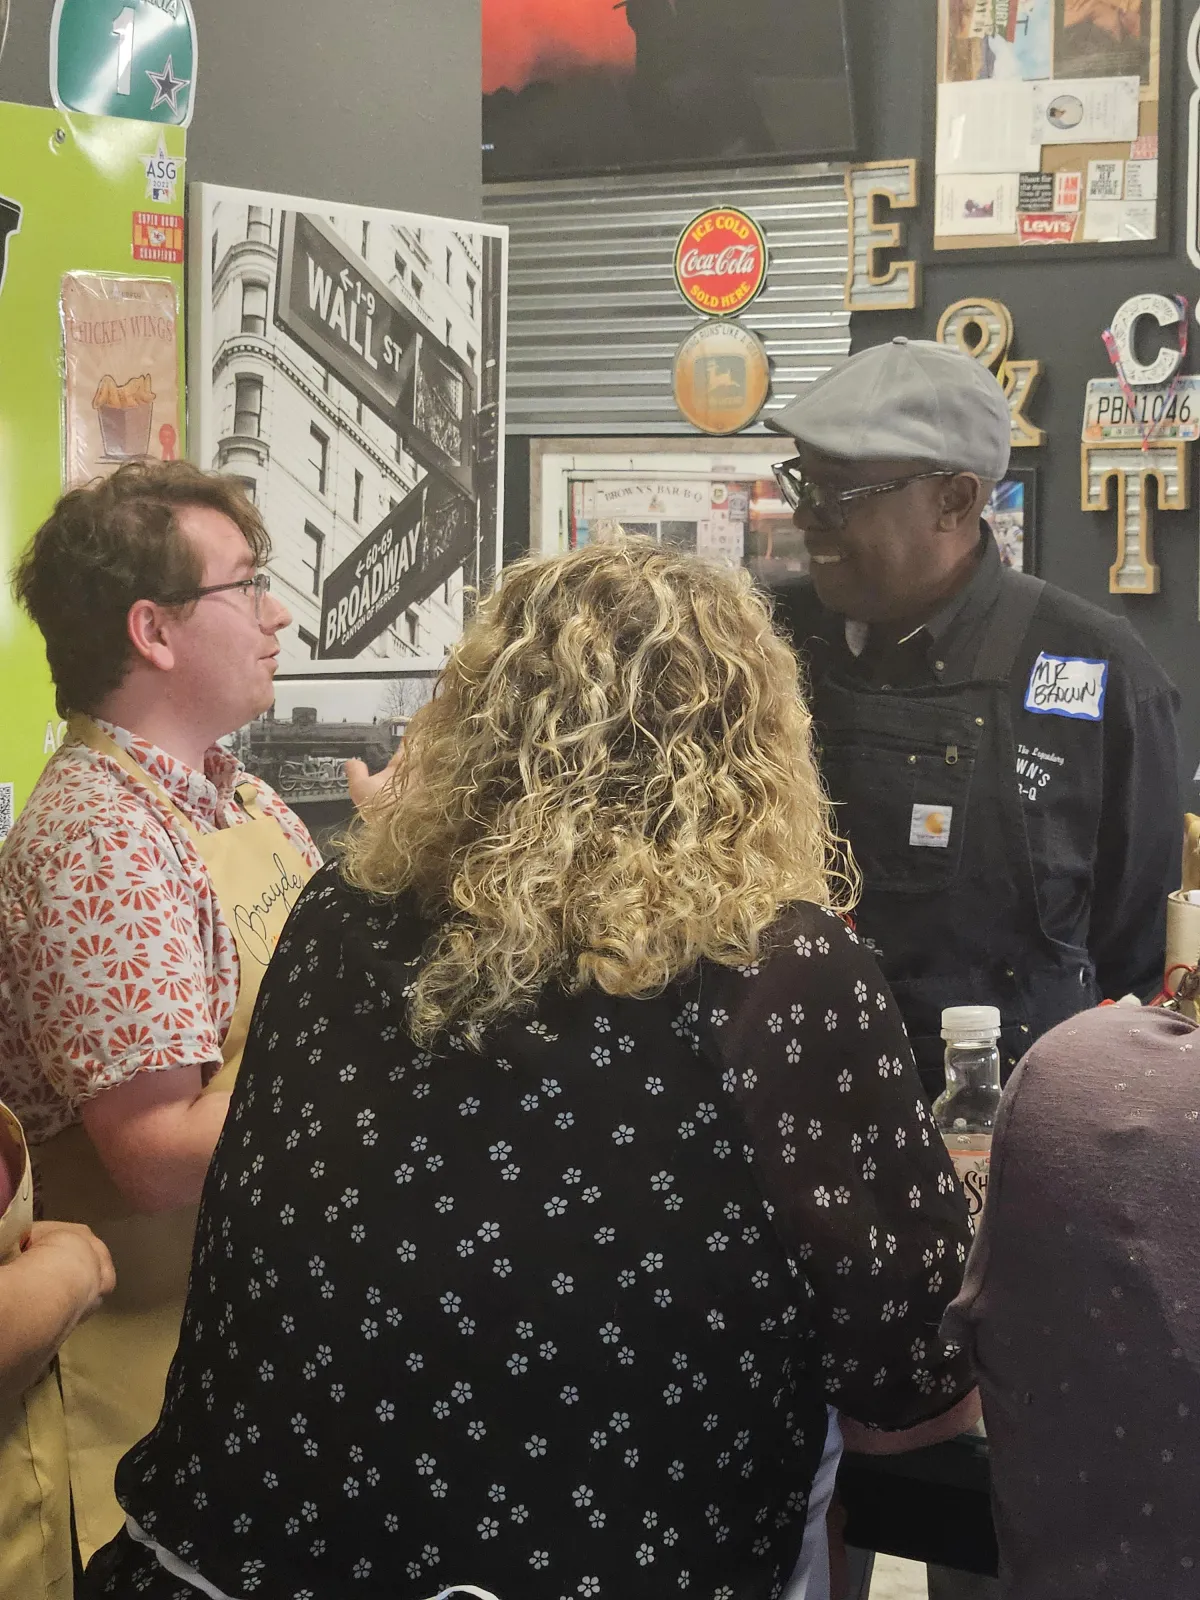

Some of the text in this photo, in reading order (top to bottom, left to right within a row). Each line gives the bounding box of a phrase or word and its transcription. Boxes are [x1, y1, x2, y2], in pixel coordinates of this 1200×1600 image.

[112, 6, 135, 95] 1
[147, 160, 176, 180] ASG
[691, 215, 750, 242] ICE COLD
[844, 159, 917, 311] E
[680, 244, 758, 278] Coca-Cola
[356, 281, 376, 315] 1-9
[690, 281, 751, 308] SOLD HERE
[130, 316, 173, 342] WINGS
[306, 252, 402, 372] WALL ST
[1097, 395, 1191, 424] PBN1046
[1081, 442, 1188, 594] T
[365, 528, 393, 570] 60-69
[325, 521, 421, 651] BROADWAY
[341, 581, 400, 646] CANYON OF HEROES
[1032, 661, 1069, 687] MR
[1017, 744, 1030, 756] The
